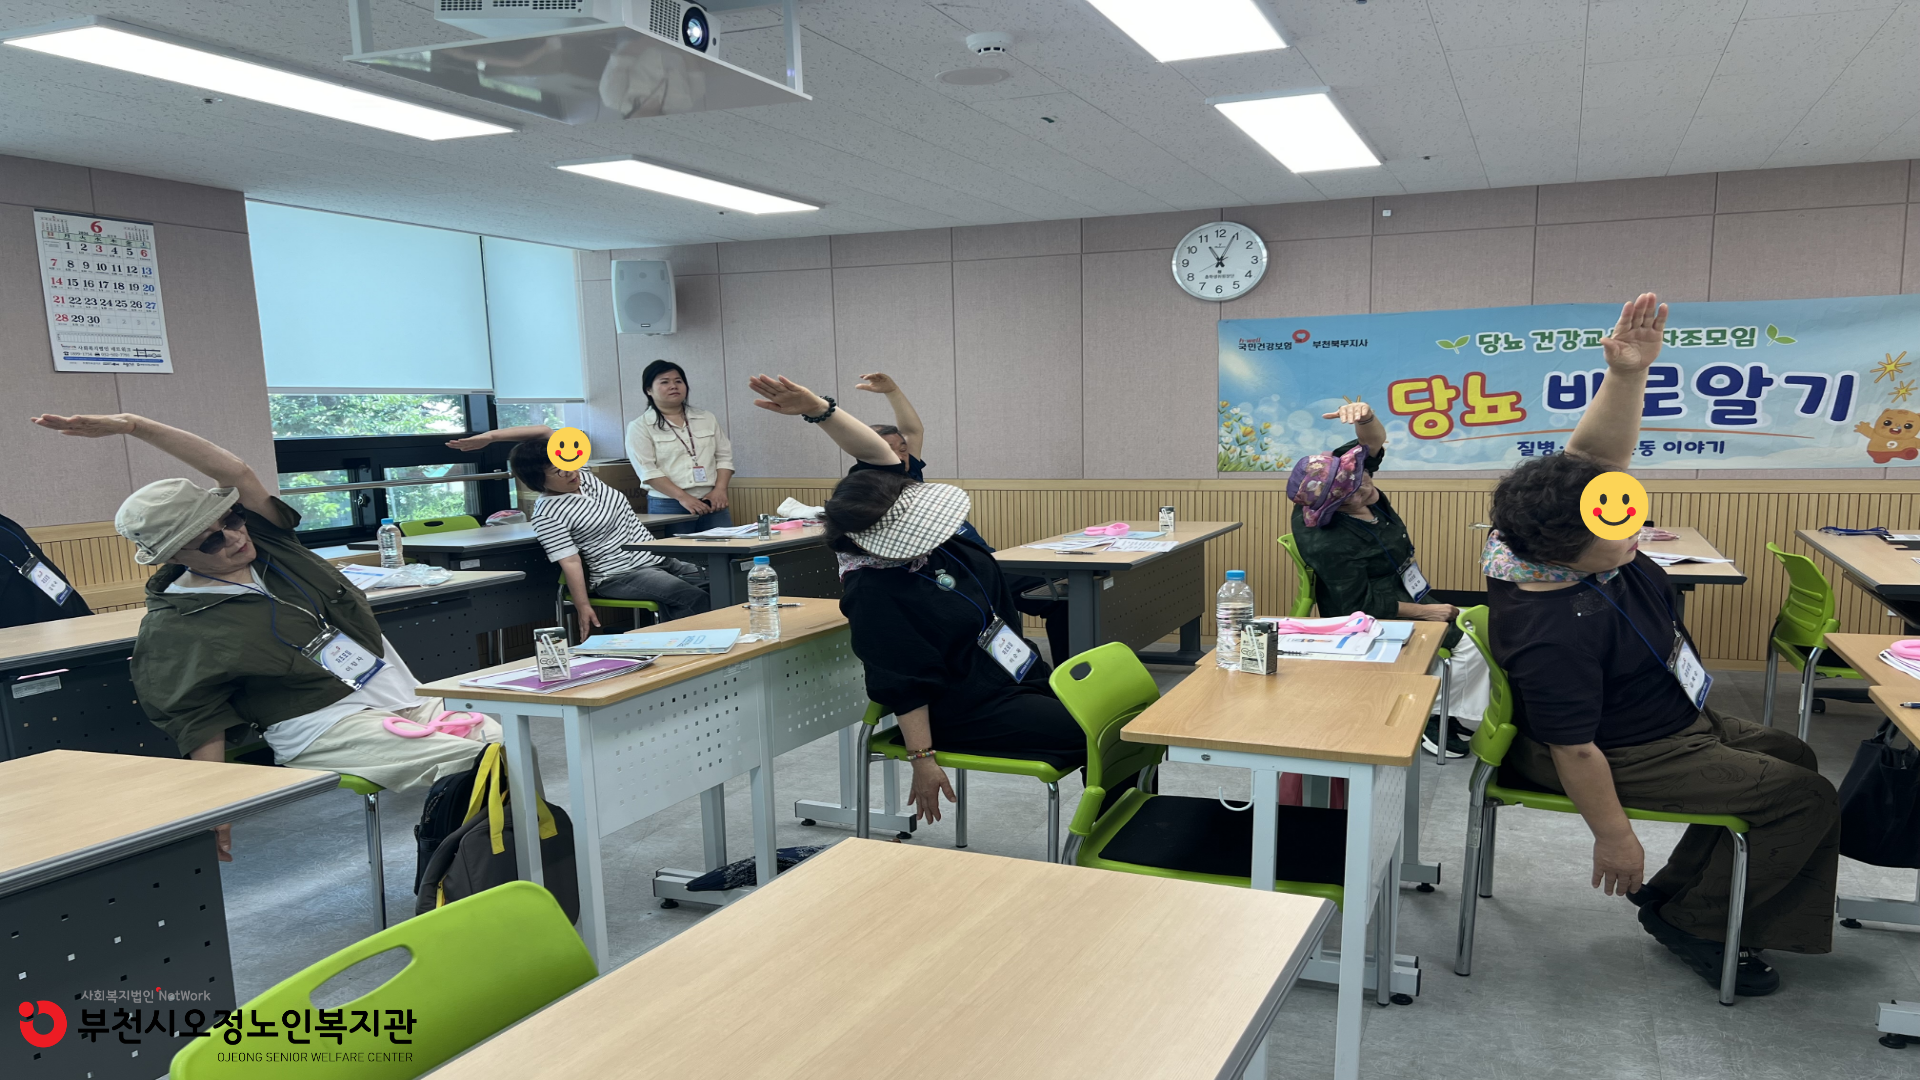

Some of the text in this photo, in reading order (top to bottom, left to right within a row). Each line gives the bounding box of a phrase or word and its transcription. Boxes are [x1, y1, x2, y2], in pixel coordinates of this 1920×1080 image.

[90, 221, 102, 233] 6
[1215, 229, 1226, 238] 12
[1199, 235, 1208, 243] 11
[1246, 241, 1253, 249] 2
[1187, 246, 1198, 254] 10
[1182, 259, 1189, 267] 9
[1251, 256, 1258, 264] 3
[67, 260, 74, 268] 8
[82, 261, 90, 269] 9
[96, 263, 108, 271] 10
[111, 264, 122, 272] 11
[126, 266, 138, 274] 12
[142, 267, 152, 275] 13
[1187, 273, 1194, 281] 8
[51, 277, 155, 293] 14 15 16 17 18 19 20
[1199, 282, 1206, 290] 7
[1215, 285, 1223, 294] 6
[1233, 281, 1240, 289] 5
[53, 295, 156, 310] 21 22 23 24 25 26 27
[55, 314, 69, 322] 28
[71, 315, 85, 323] 29
[87, 316, 100, 324] 30
[1312, 338, 1368, 350] 부천북부지사
[1478, 327, 1757, 353] 당뇨 건강교 자조모임
[1238, 342, 1293, 351] 국민건강보험
[1388, 372, 1527, 440] 당뇨
[1663, 440, 1725, 454] 이야기
